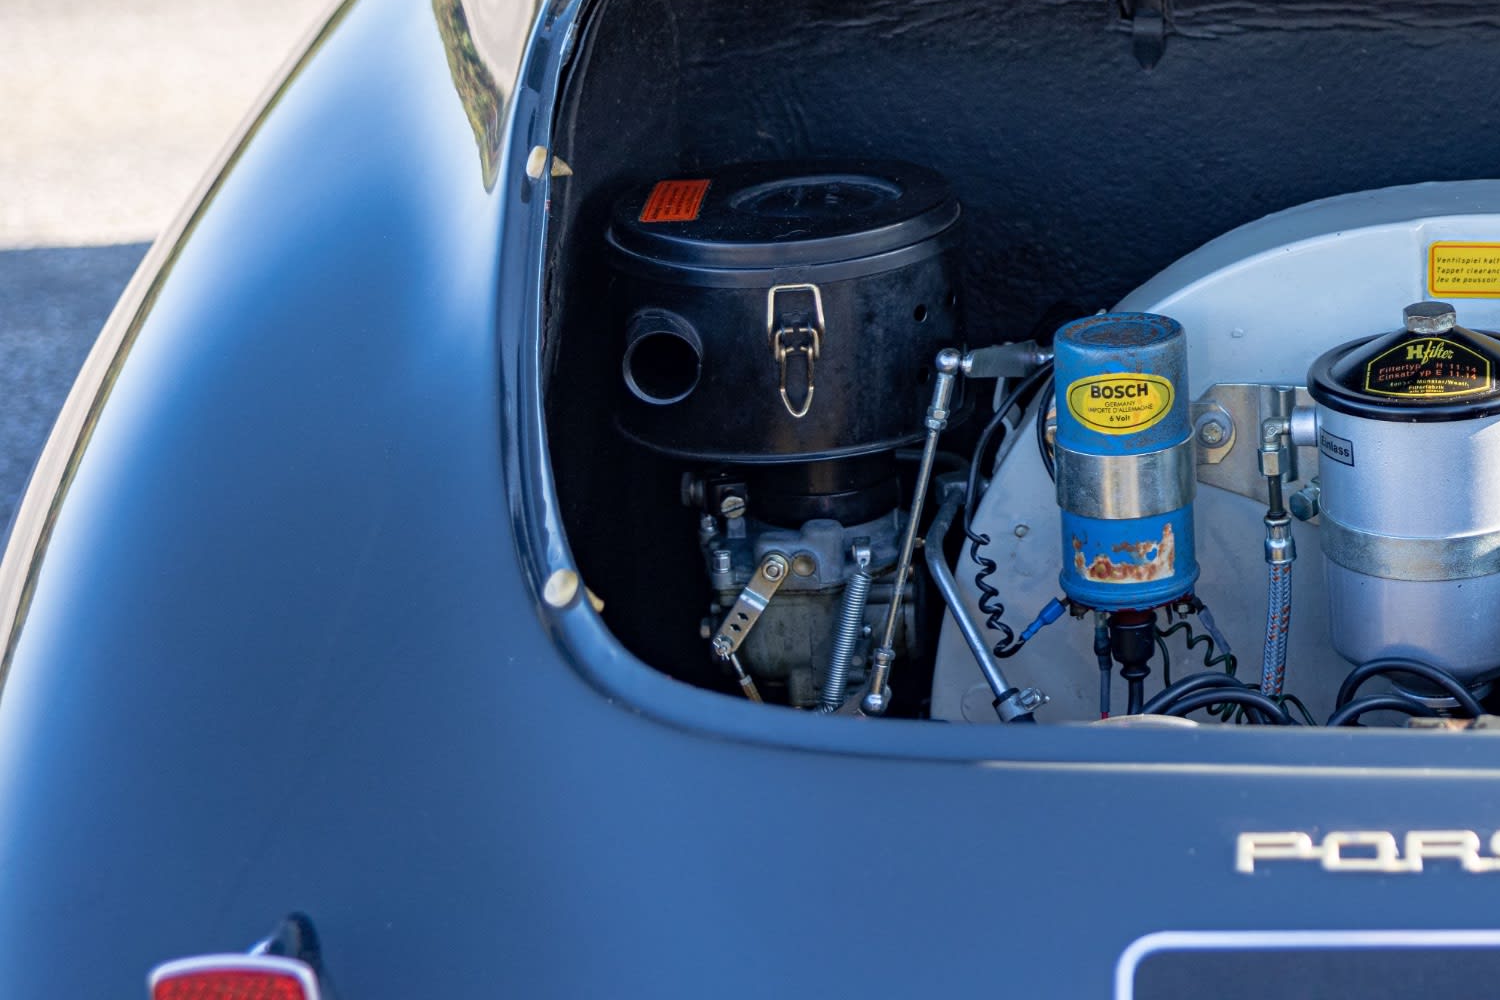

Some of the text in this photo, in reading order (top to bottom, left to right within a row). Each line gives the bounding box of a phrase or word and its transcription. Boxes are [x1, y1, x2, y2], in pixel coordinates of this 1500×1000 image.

[1379, 362, 1421, 375] Filtertyp
[1449, 370, 1477, 380] 11.14
[1090, 383, 1149, 399] BOSCH
[1104, 400, 1136, 408] GERMANY
[1320, 435, 1350, 457] Einlass
